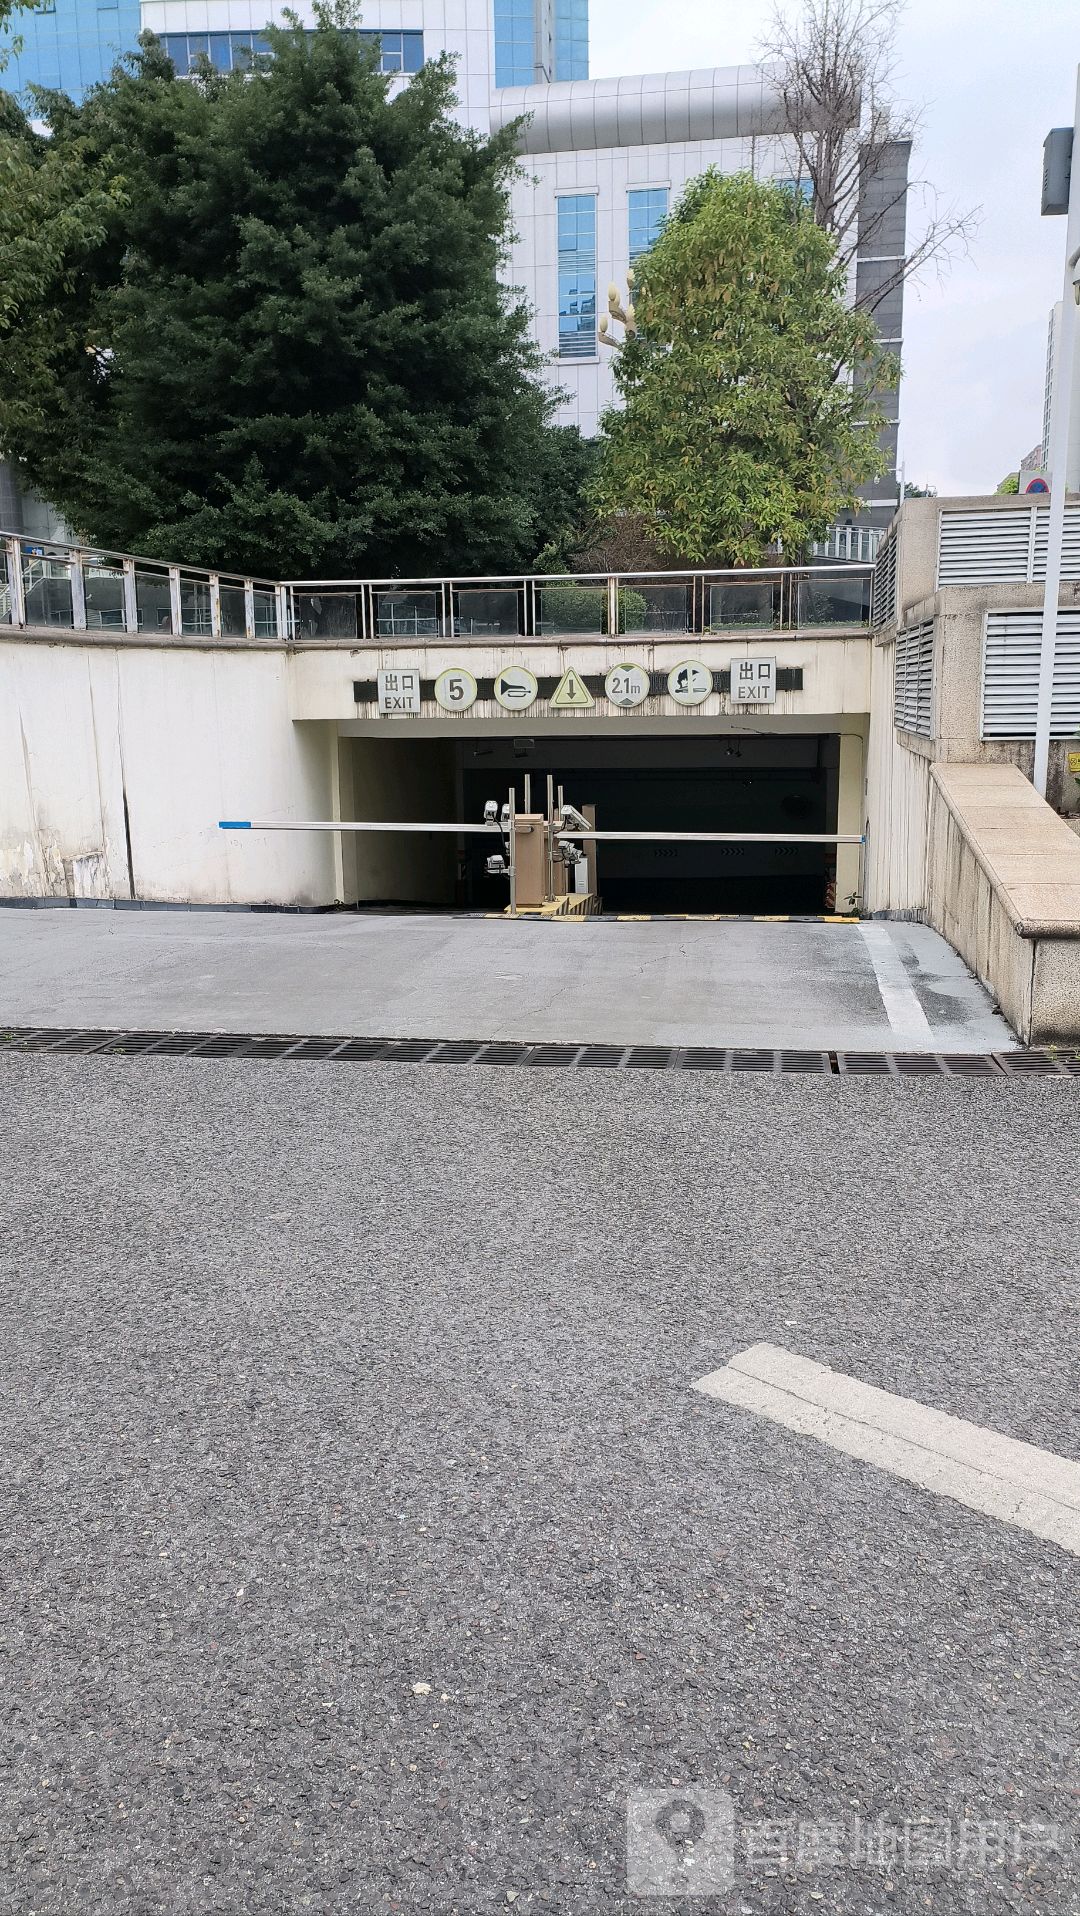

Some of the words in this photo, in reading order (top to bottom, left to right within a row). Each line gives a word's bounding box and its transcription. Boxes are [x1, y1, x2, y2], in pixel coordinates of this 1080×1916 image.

[739, 661, 771, 681] 出口
[385, 673, 414, 692] 出口
[449, 678, 465, 701] 5
[611, 677, 641, 694] 2.1m
[738, 685, 771, 699] EXIT
[384, 696, 415, 709] EXIT
